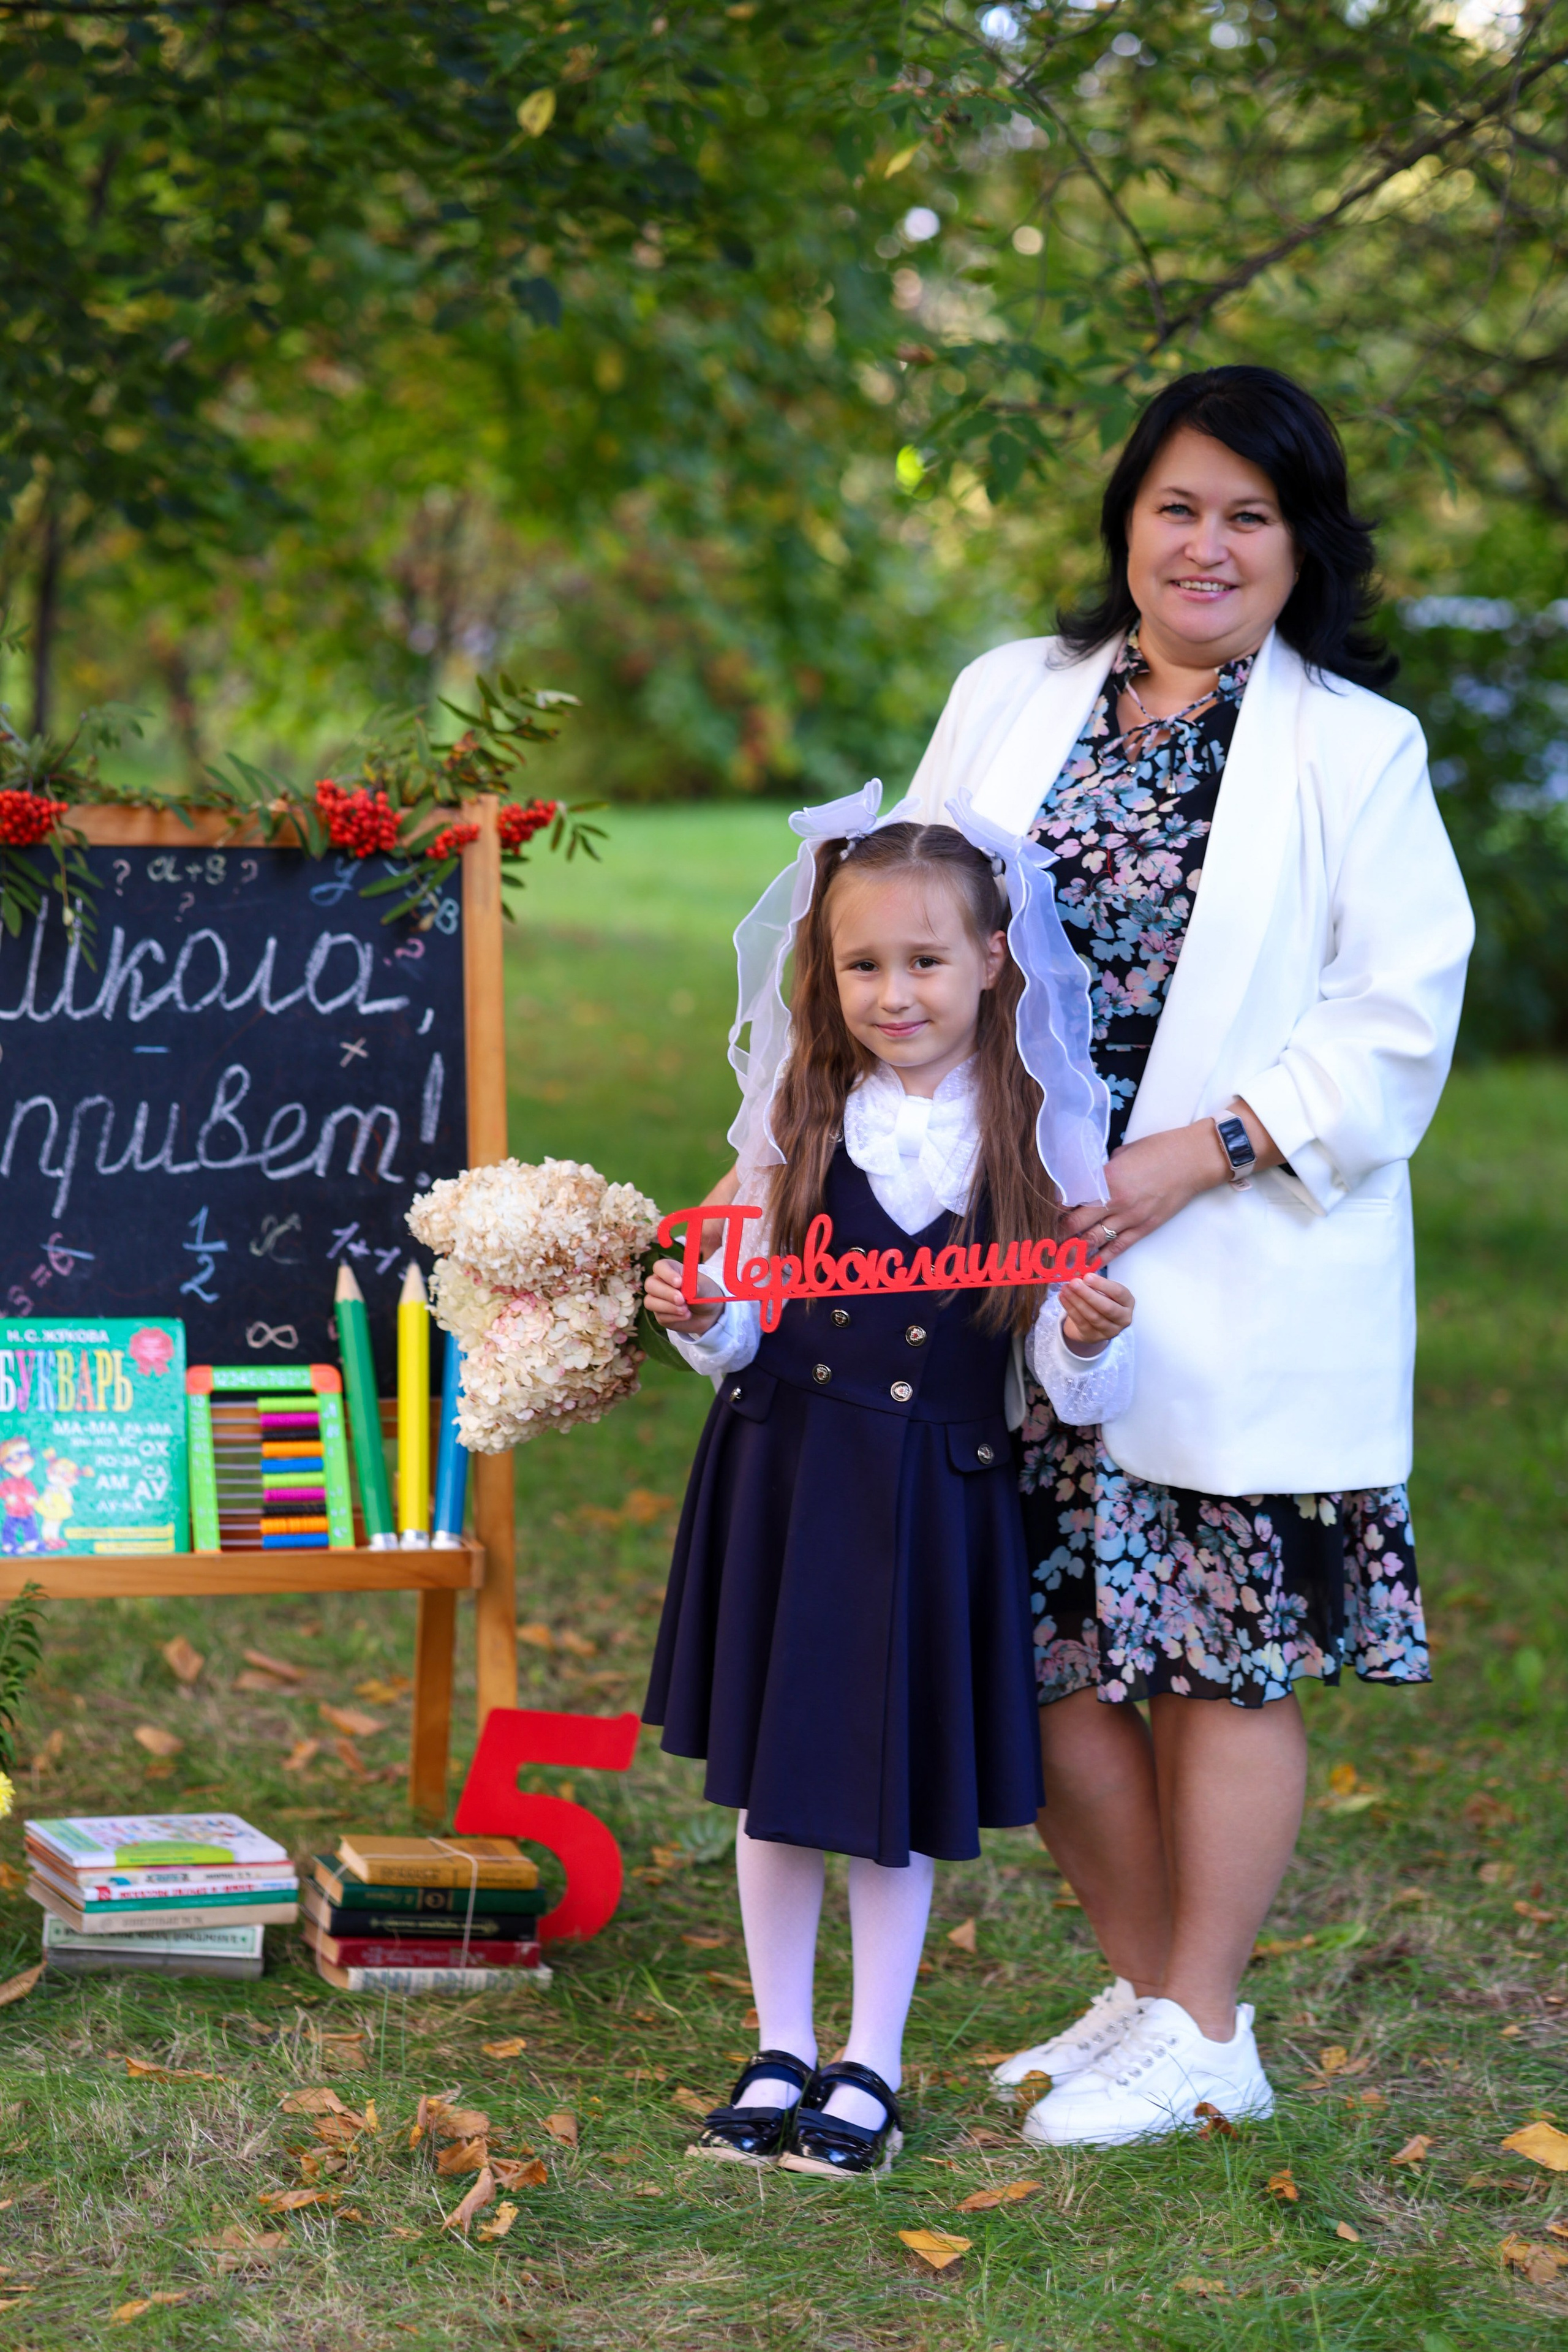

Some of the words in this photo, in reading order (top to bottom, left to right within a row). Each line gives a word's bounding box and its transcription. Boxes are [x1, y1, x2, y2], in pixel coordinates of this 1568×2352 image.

[0, 1052, 444, 1219] привет!
[657, 1205, 1102, 1333] Первоклашка
[0, 1349, 134, 1413] БУКВАРЬ
[132, 1479, 169, 1501] АУ
[454, 1706, 641, 1943] 5
